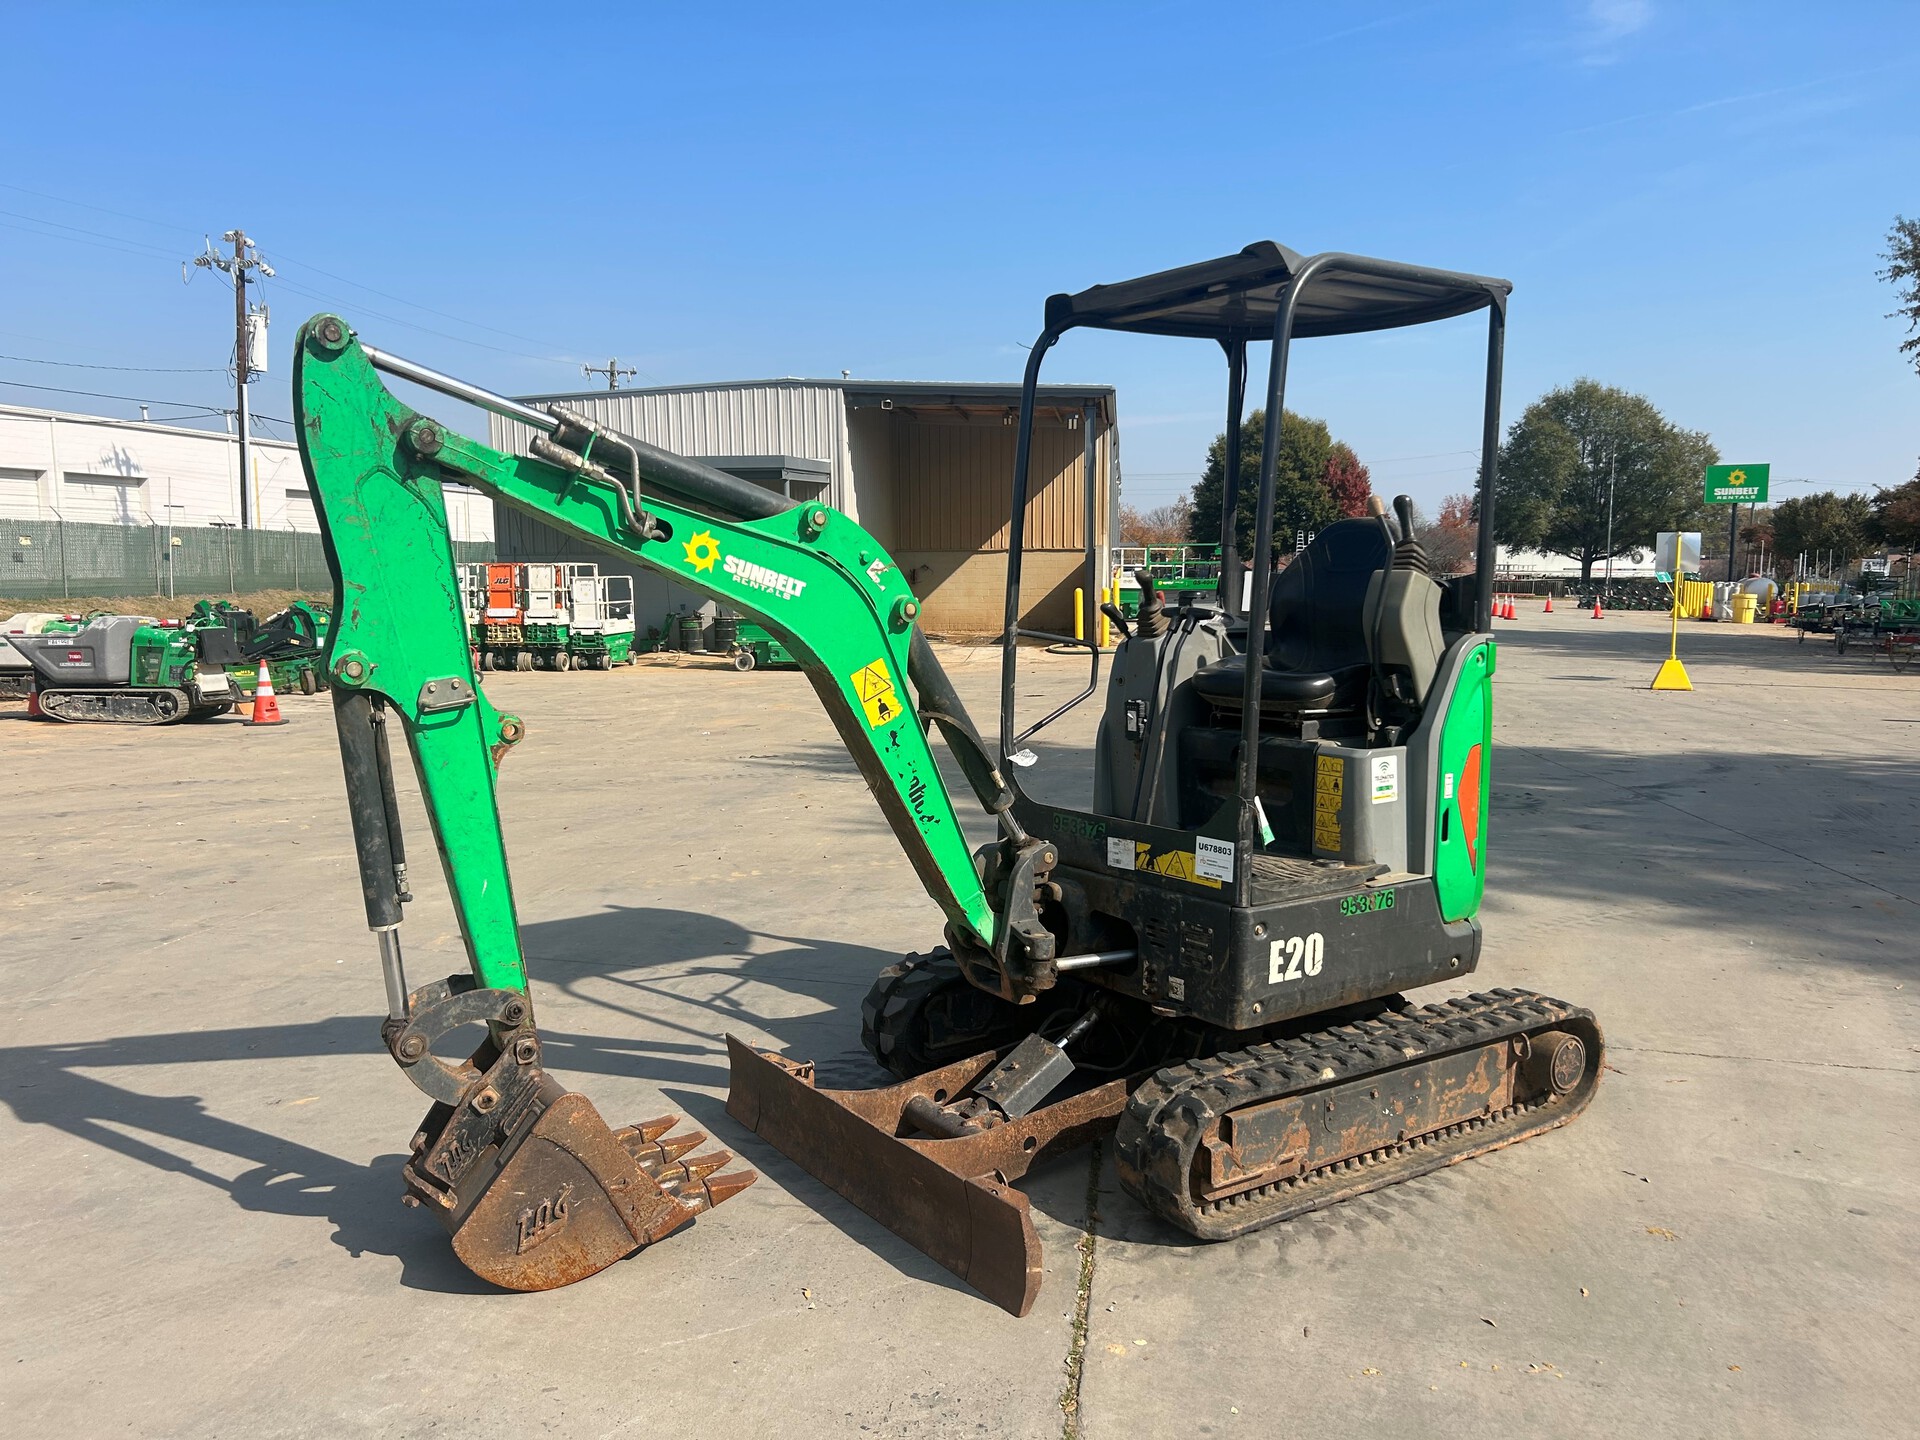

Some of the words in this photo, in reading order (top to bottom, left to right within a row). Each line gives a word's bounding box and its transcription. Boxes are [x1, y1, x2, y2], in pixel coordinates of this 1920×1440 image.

[1713, 487, 1759, 496] SUNBELT
[722, 554, 807, 597] SUNBELT
[732, 574, 791, 600] RENTALS
[1199, 843, 1232, 856] U678803
[1268, 932, 1324, 984] E20
[515, 1181, 573, 1256] TAG
